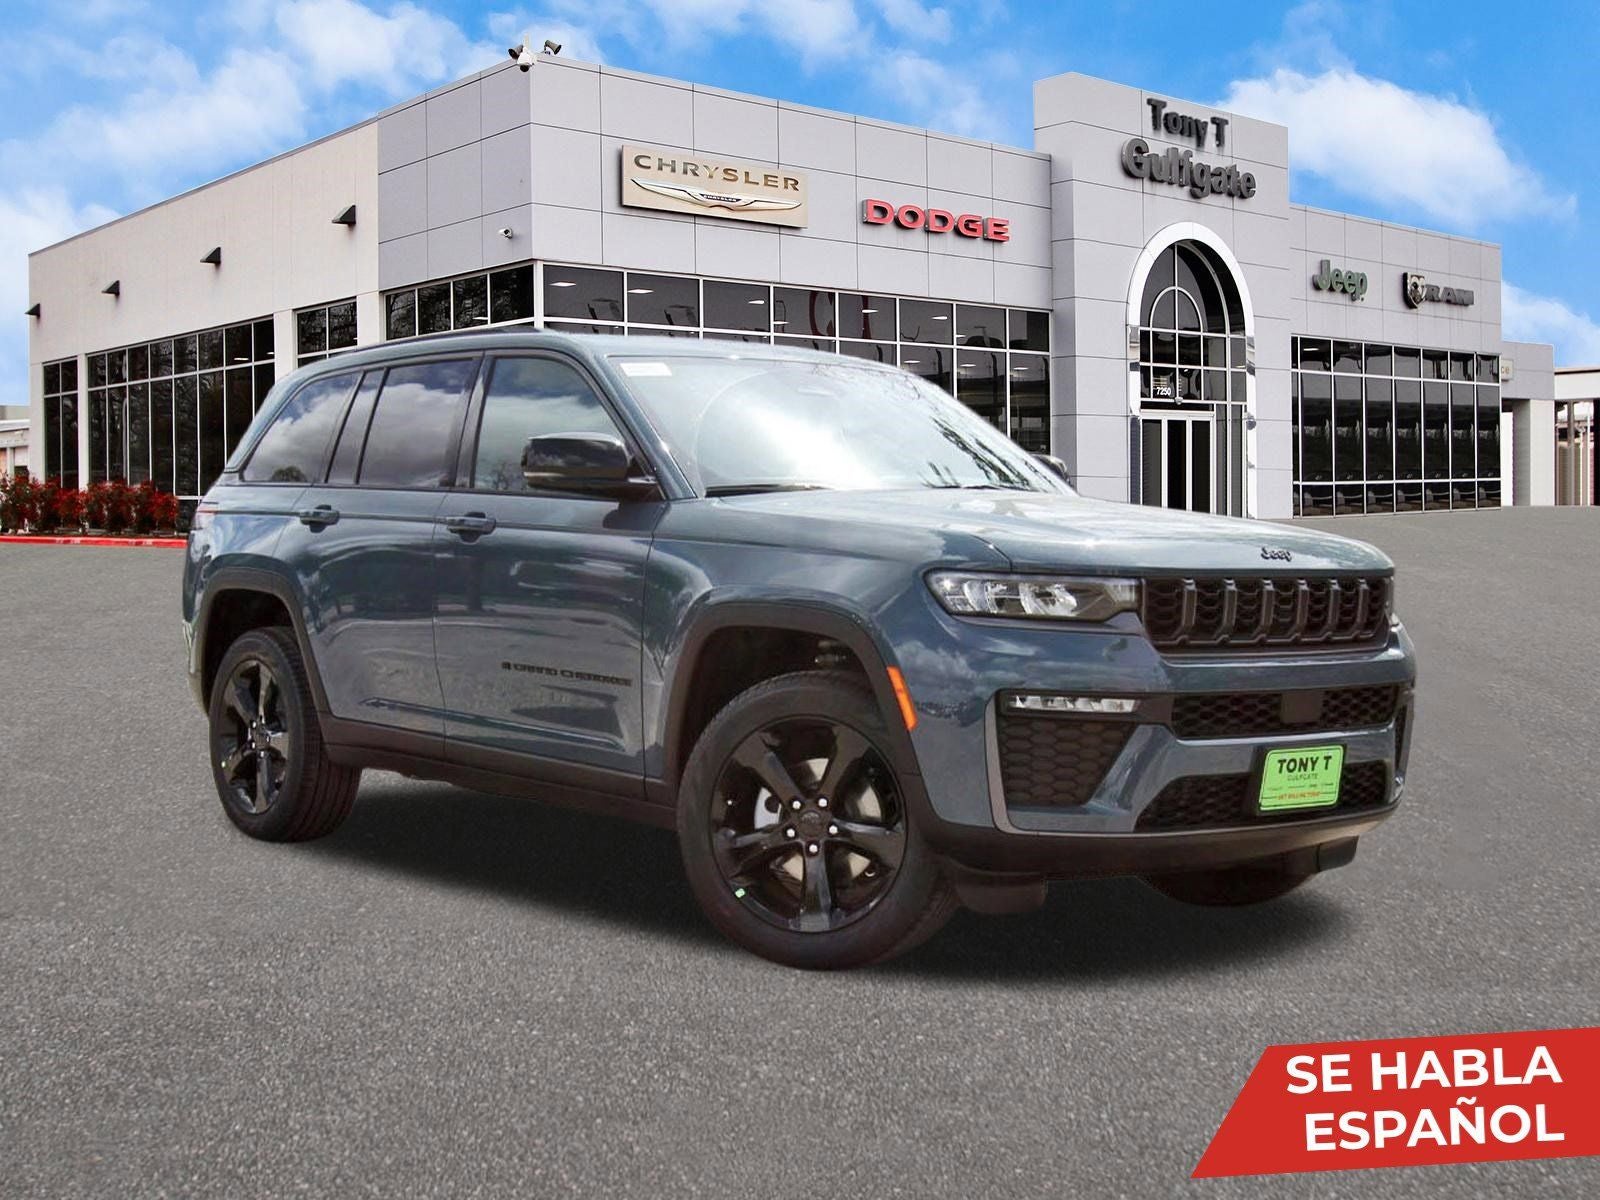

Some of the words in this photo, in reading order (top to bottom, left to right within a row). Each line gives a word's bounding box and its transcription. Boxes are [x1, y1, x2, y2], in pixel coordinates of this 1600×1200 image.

[1147, 98, 1208, 147] Tony
[1210, 117, 1229, 147] T
[633, 154, 800, 192] CHRYSLER
[1121, 138, 1257, 199] Gulfgate
[862, 198, 1010, 242] DODGE
[1312, 259, 1368, 300] Jeep
[1425, 284, 1474, 306] RAM
[1156, 387, 1172, 396] 7250
[1261, 547, 1292, 562] Jeep
[1277, 756, 1319, 774] TONY
[1323, 755, 1332, 770] T
